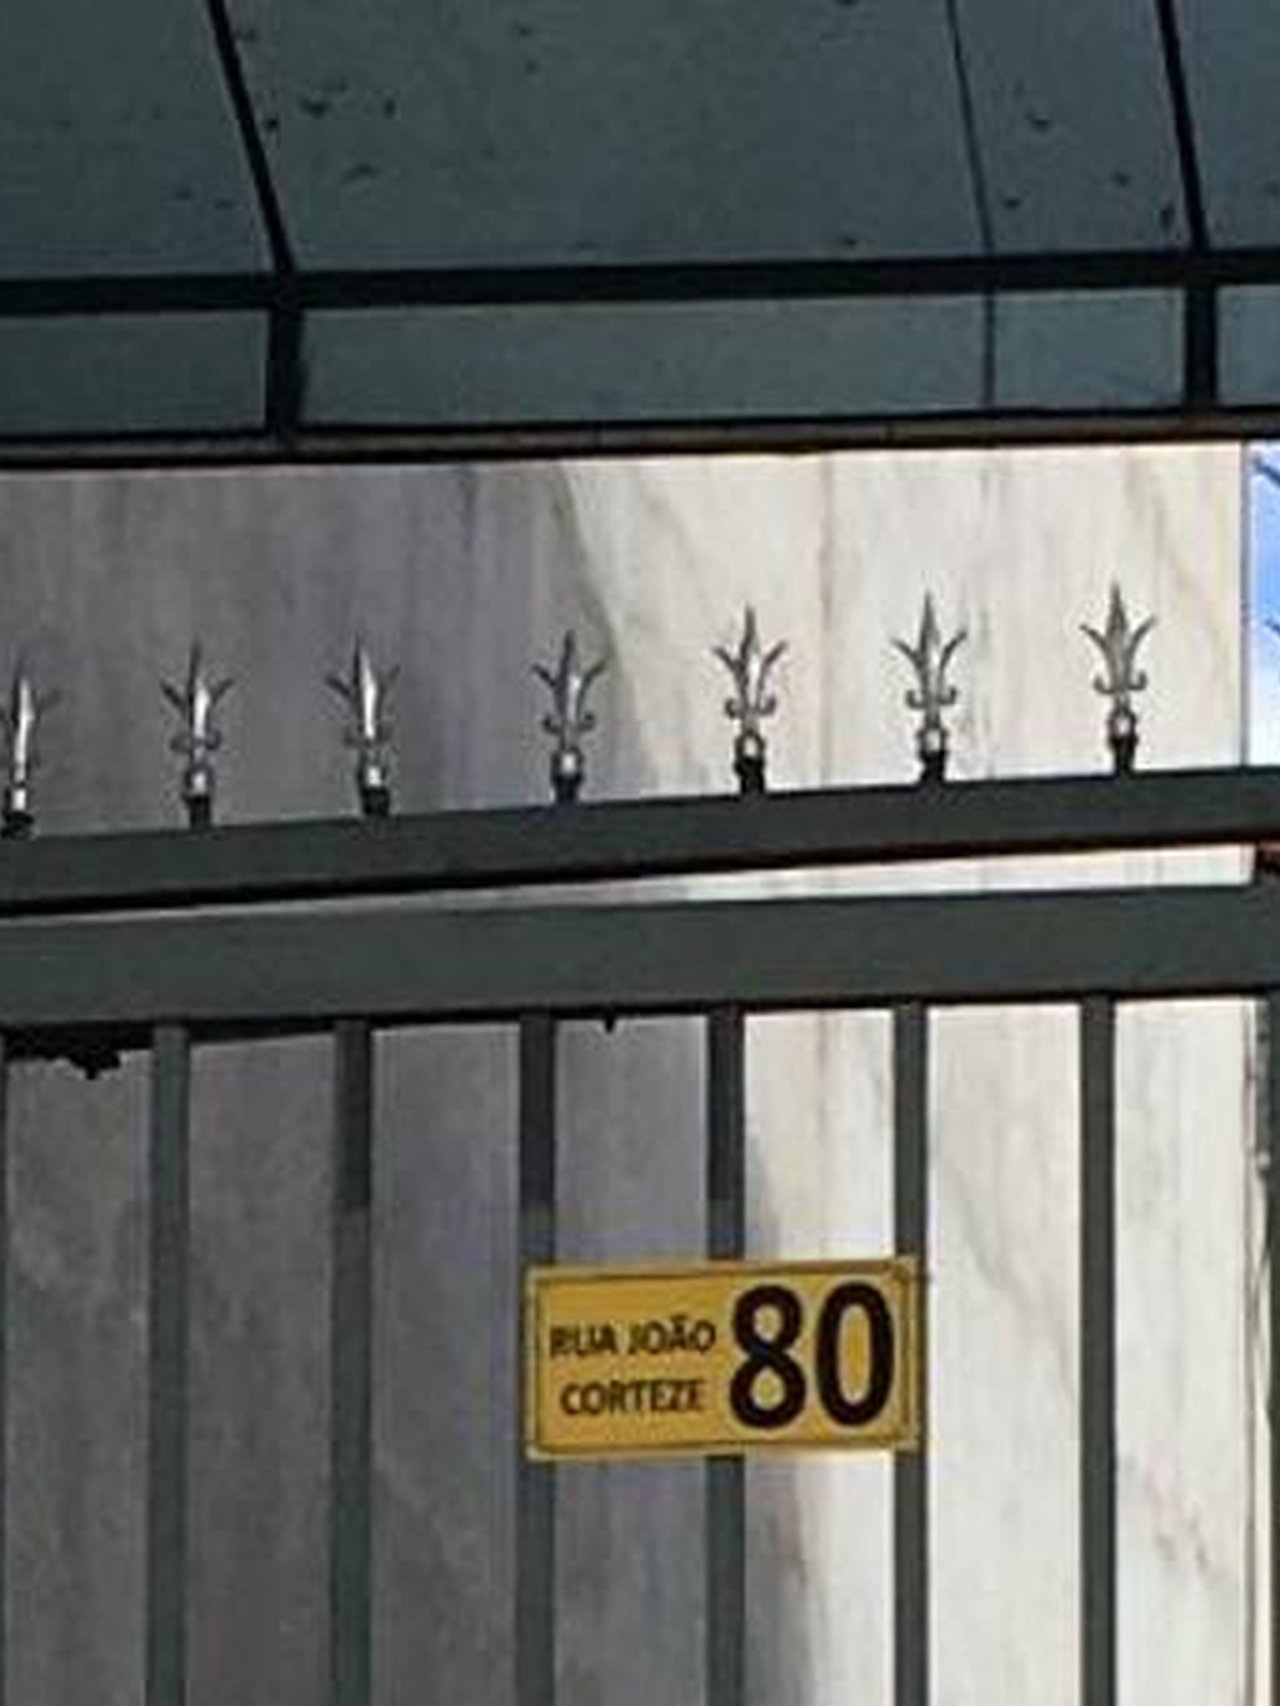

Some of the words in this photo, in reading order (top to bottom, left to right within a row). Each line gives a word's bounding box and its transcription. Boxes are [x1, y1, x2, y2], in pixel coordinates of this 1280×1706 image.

[549, 1323, 617, 1357] RUA
[626, 1314, 716, 1356] JOÃO
[729, 1281, 896, 1429] 80
[559, 1378, 705, 1417] CORTEZE
